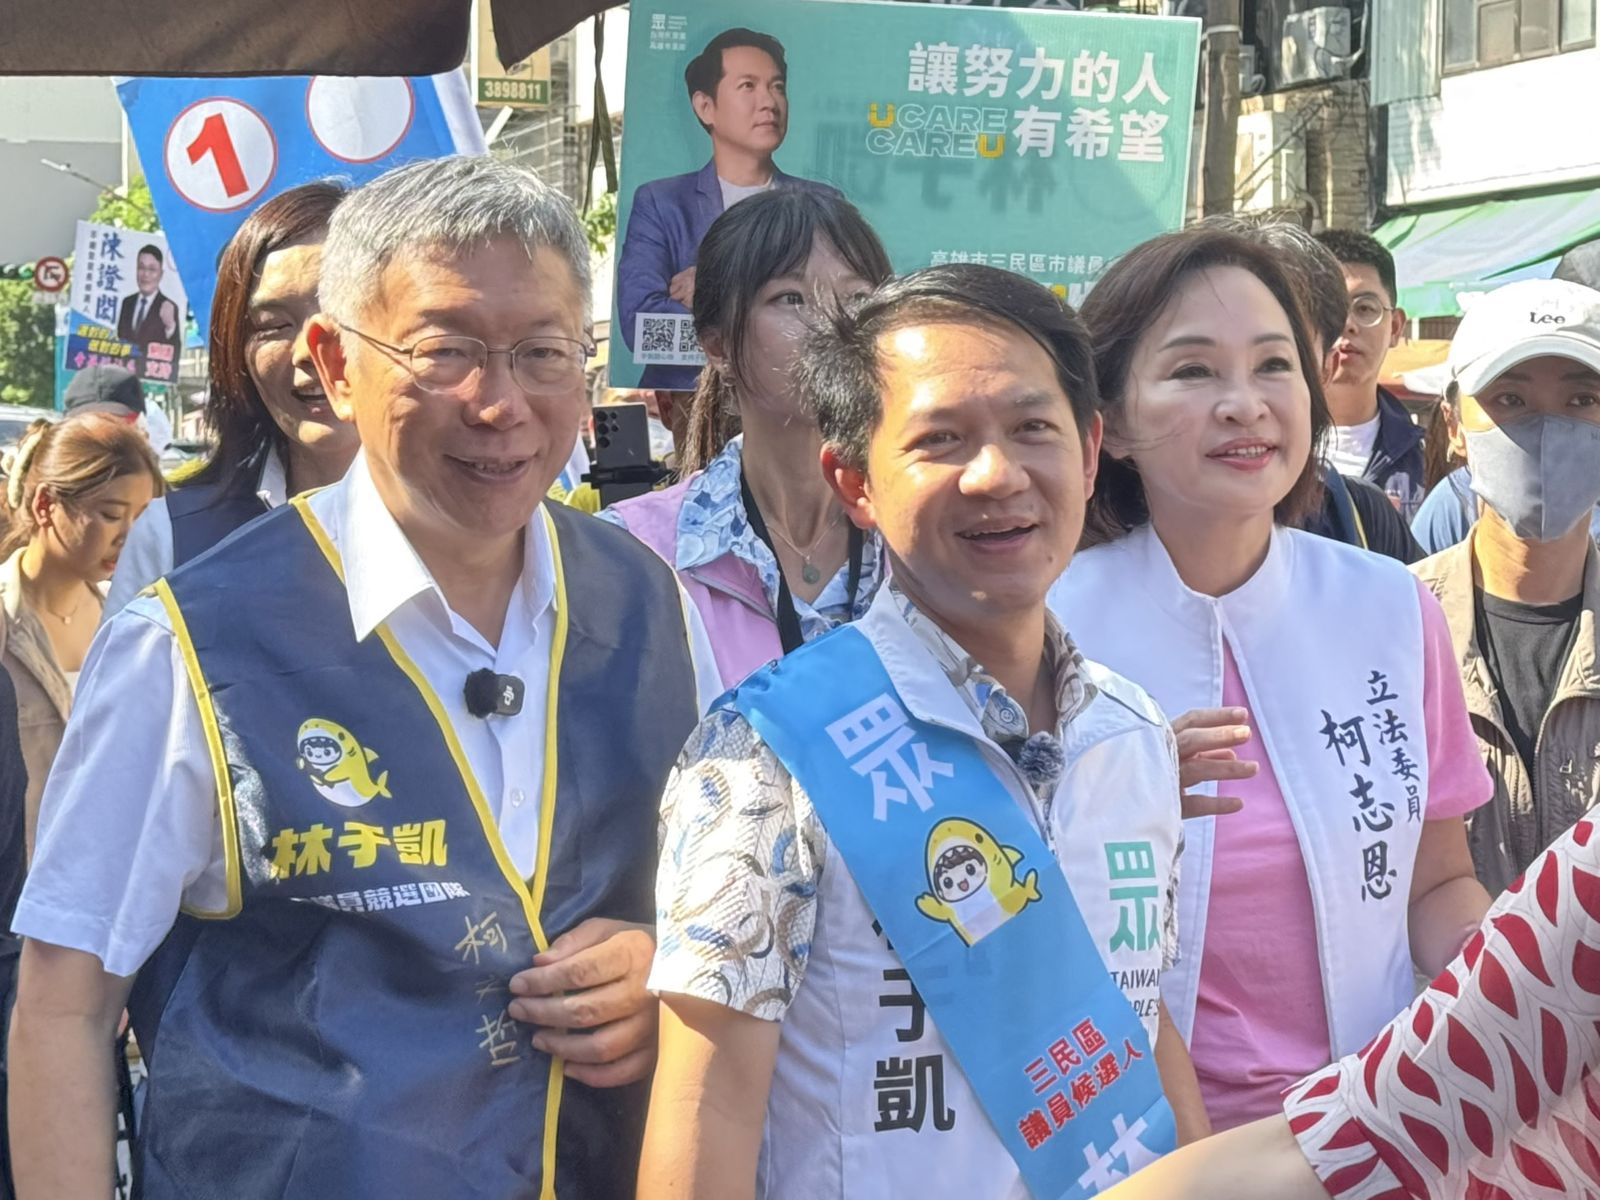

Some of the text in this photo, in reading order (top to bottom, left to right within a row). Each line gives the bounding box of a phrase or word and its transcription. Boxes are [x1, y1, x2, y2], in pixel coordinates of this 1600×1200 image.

[484, 81, 541, 99] 3898811
[908, 42, 1171, 105] 讓努力的人
[187, 112, 250, 198] 1
[1012, 105, 1169, 162] 有希望
[1530, 311, 1566, 324] Lee
[824, 692, 954, 822] 眾
[1366, 670, 1421, 823] 立法委員
[1319, 709, 1397, 902] 柯志恩
[269, 819, 448, 880] 林于凱
[291, 881, 470, 912] 員競選團隊
[1104, 841, 1160, 953] 眾
[1110, 968, 1160, 991] TAIWA
[872, 918, 956, 1134] 于凱
[1024, 1017, 1106, 1095] 三民區
[1018, 1038, 1143, 1150] 議員候選人
